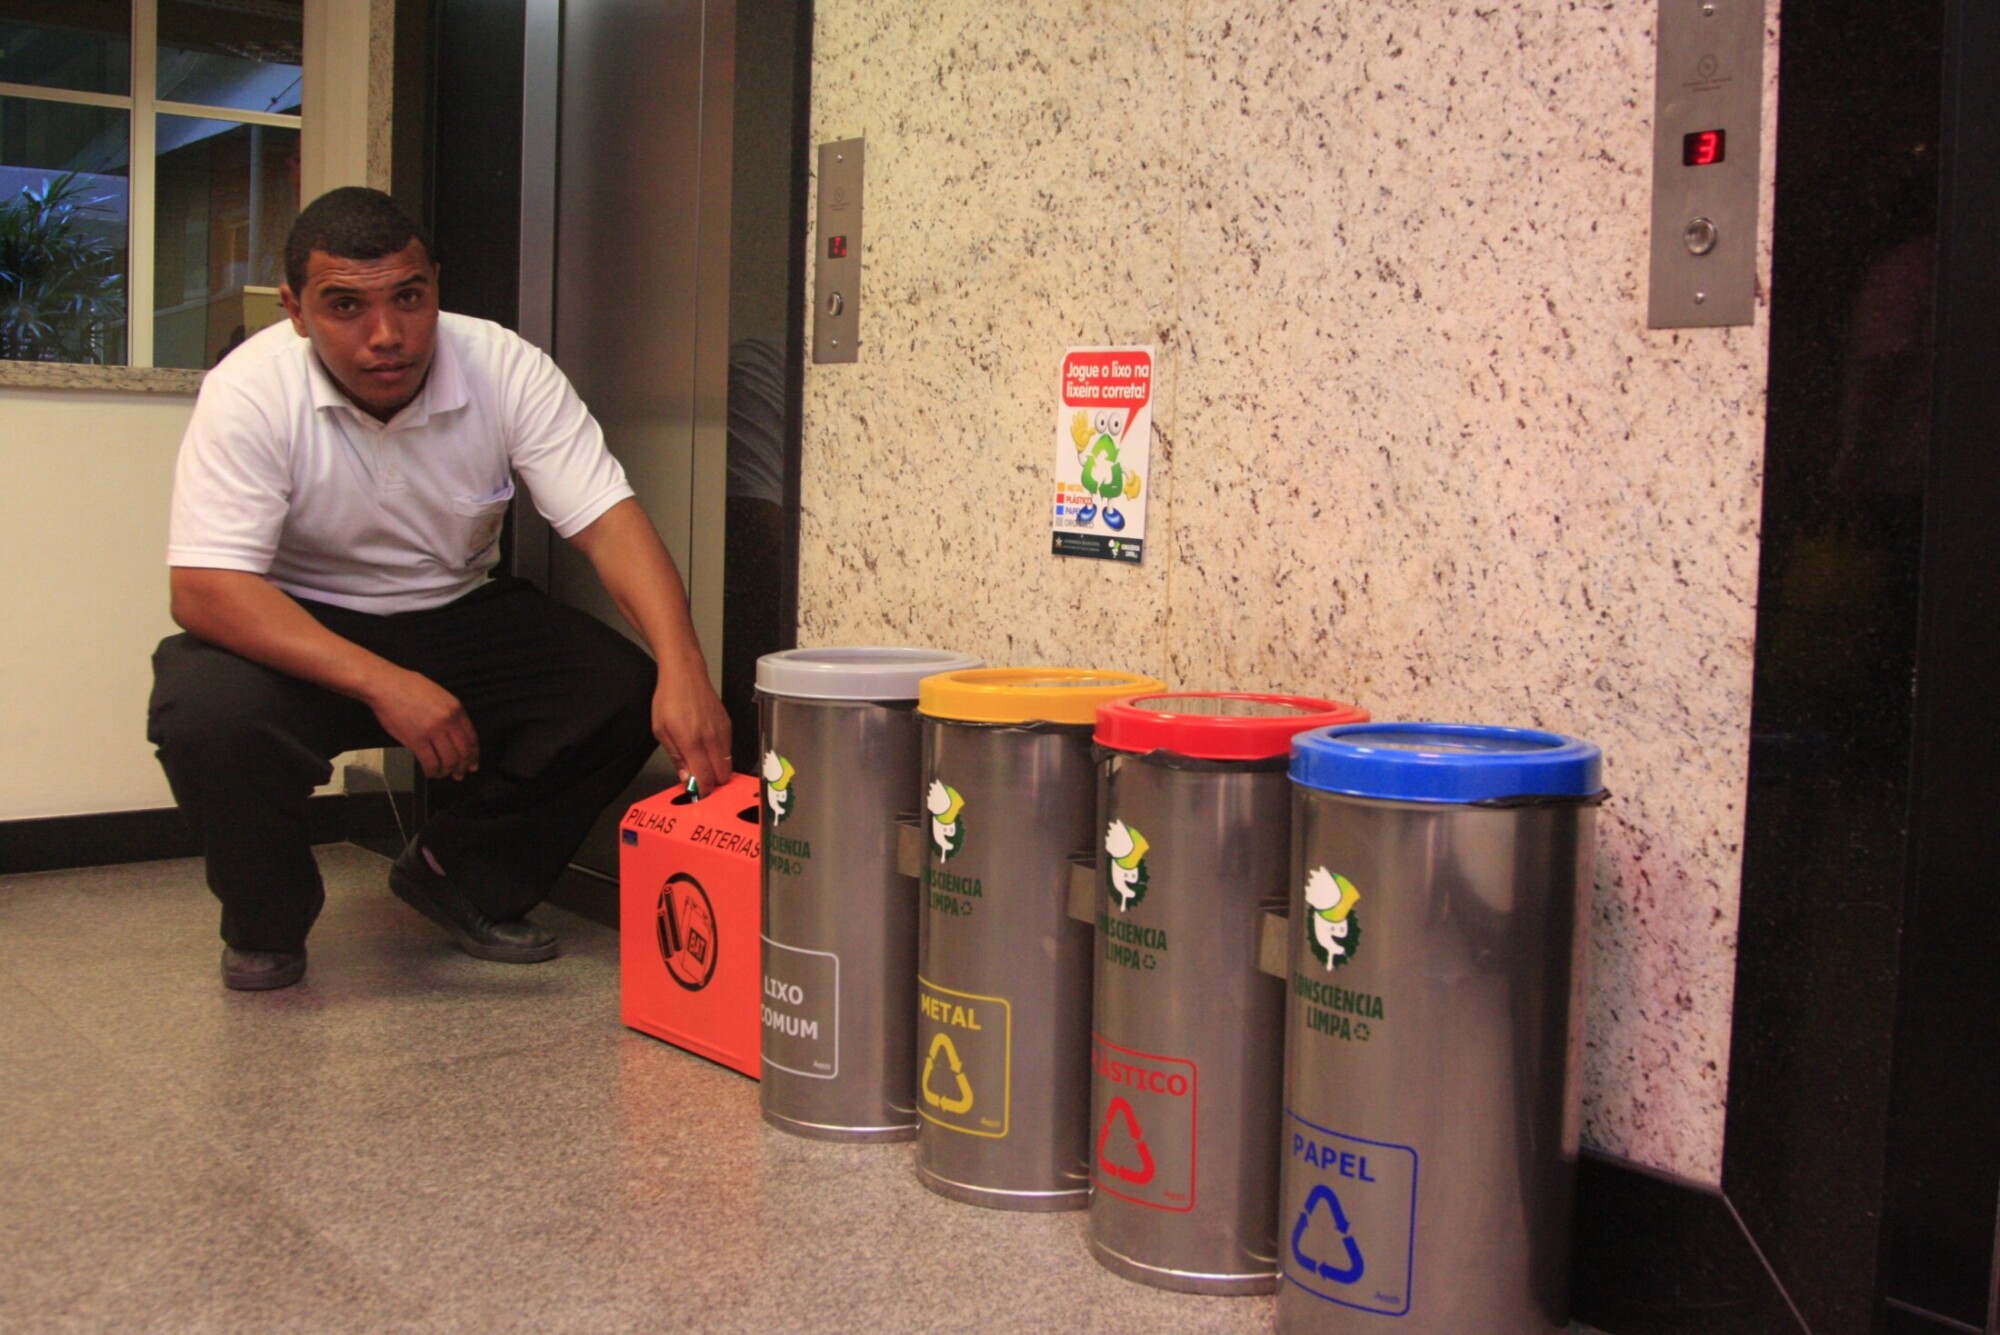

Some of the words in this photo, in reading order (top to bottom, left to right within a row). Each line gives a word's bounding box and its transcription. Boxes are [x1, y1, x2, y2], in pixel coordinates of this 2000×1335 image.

[1697, 131, 1718, 164] 3
[1066, 362, 1099, 382] Jogue
[1102, 365, 1109, 378] o
[1112, 361, 1131, 377] lixo
[1134, 365, 1149, 378] na
[1066, 381, 1099, 398] lixeira
[1102, 382, 1146, 398] correta!
[626, 809, 677, 834] PILHAS
[690, 825, 760, 858] BATERIAS
[764, 975, 804, 1006] LIXO
[761, 1003, 819, 1041] COMUM
[921, 993, 982, 1030] METAL
[1307, 1005, 1351, 1041] LIMPA
[1293, 1133, 1376, 1183] PAPEL
